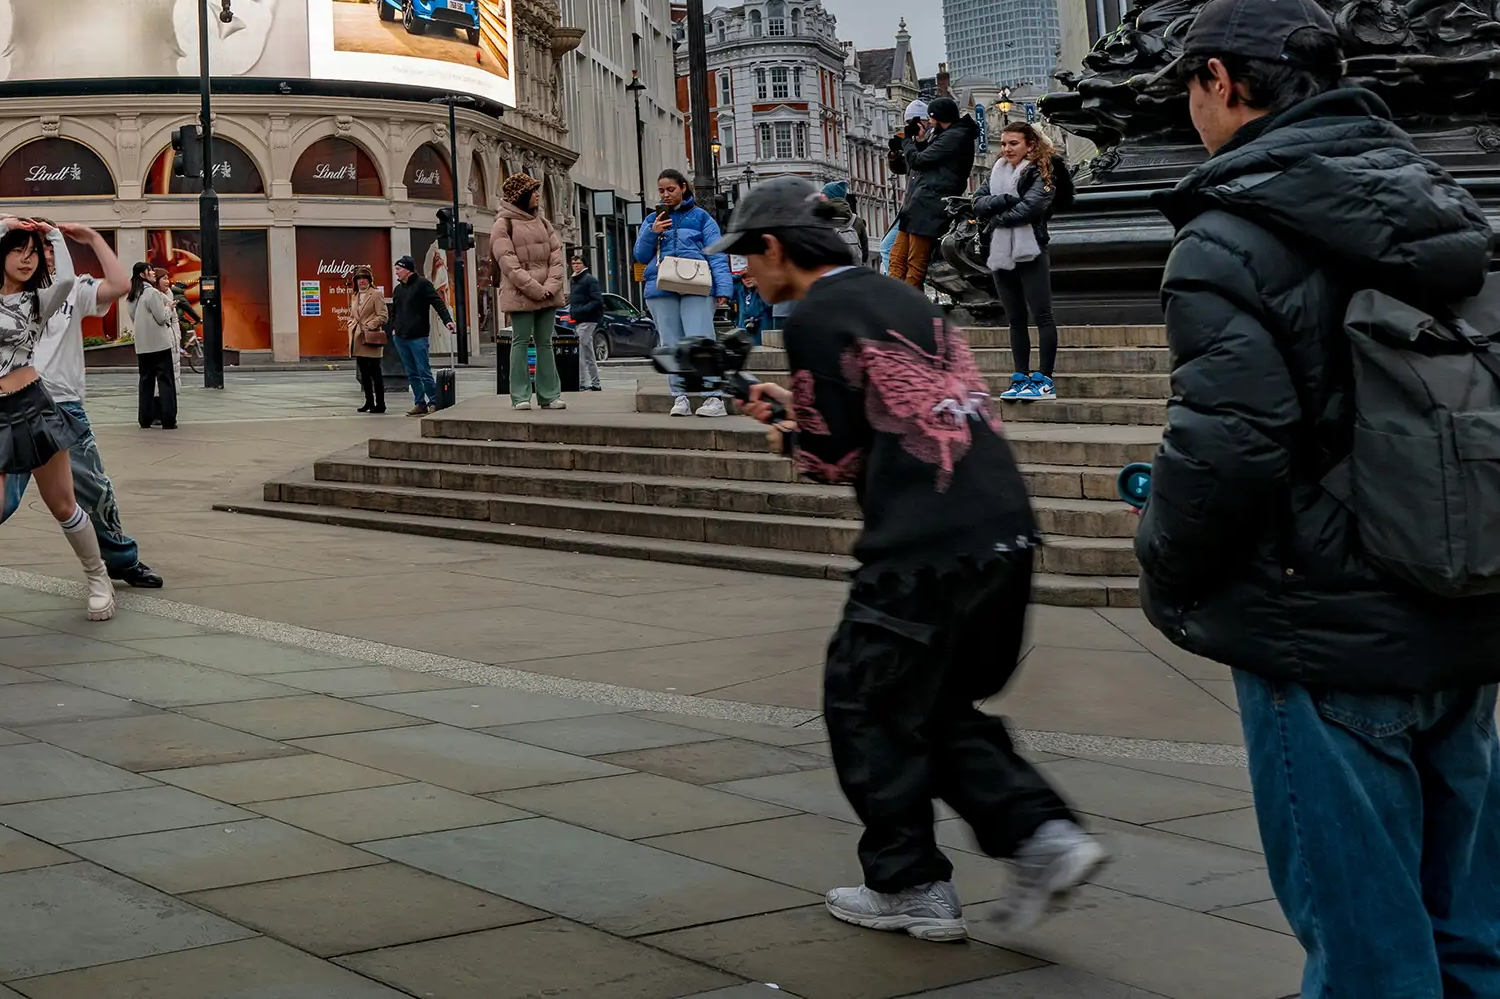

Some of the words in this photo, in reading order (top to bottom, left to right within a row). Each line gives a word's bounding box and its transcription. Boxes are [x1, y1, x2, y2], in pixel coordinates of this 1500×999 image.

[976, 112, 987, 151] LYRIC
[23, 164, 71, 183] Lindt
[312, 163, 349, 180] Lindt
[414, 169, 435, 185] Lindt
[329, 286, 336, 294] in
[336, 286, 346, 294] the
